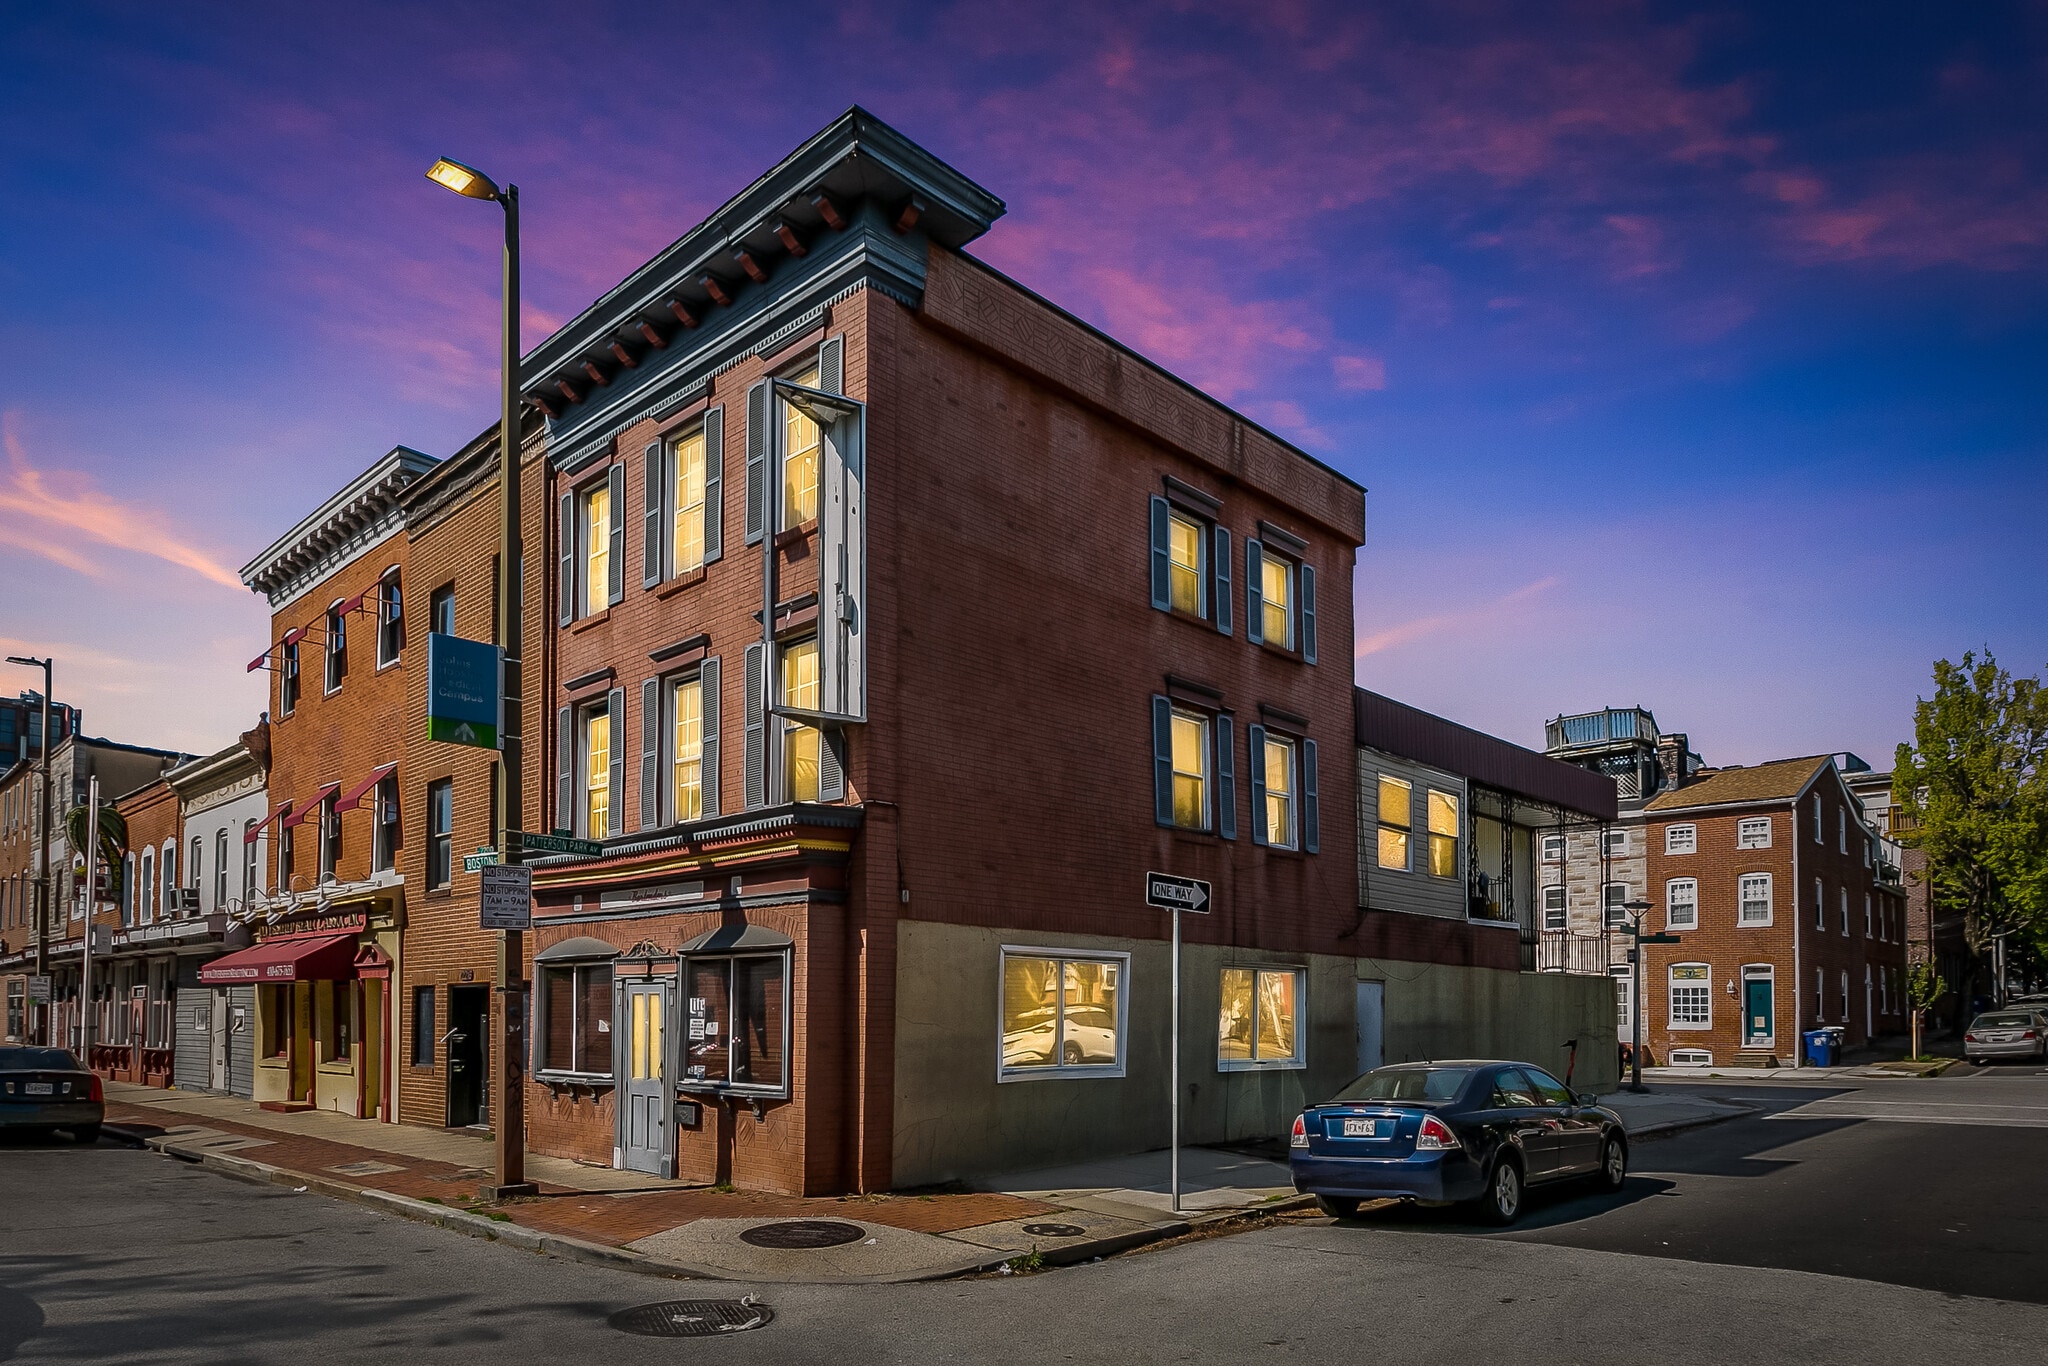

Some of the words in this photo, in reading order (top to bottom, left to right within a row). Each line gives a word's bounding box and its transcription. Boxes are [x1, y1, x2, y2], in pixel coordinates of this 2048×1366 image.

[439, 677, 481, 691] edical
[439, 687, 483, 702] Campus
[525, 835, 567, 852] PATTERSON
[569, 842, 588, 854] PARK
[466, 857, 494, 870] BOSTON
[483, 867, 496, 877] NO
[497, 868, 528, 879] STOPPING
[483, 884, 496, 893] NO
[497, 885, 528, 896] STOPPING
[1154, 883, 1172, 898] ONE
[1174, 886, 1193, 901] WAY
[689, 997, 706, 1014] Lite
